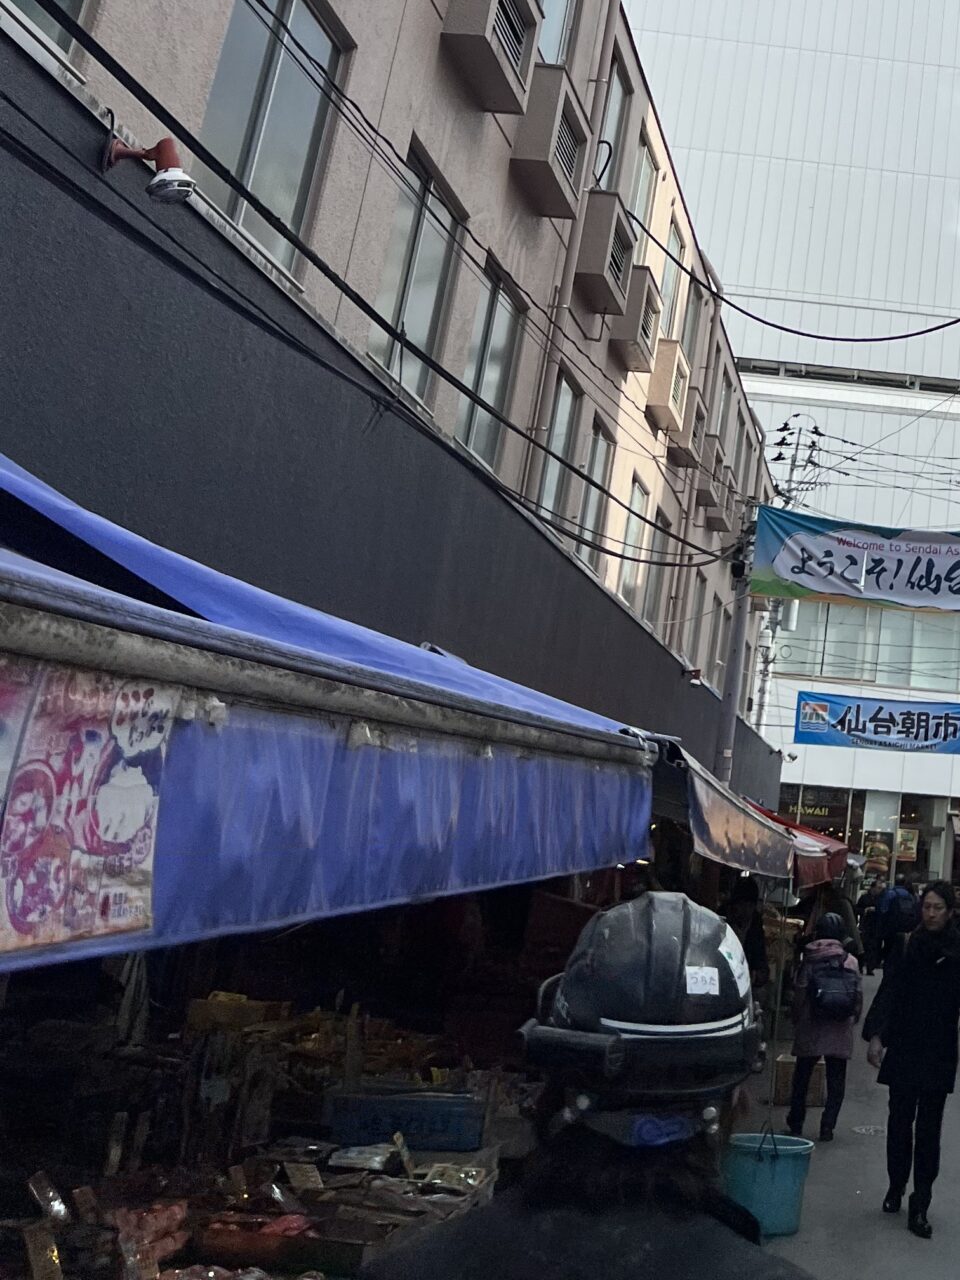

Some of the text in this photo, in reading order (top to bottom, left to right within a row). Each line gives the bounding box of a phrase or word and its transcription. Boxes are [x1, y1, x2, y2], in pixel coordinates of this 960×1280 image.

[836, 536, 885, 552] Welcome
[889, 542, 902, 553] to
[904, 543, 943, 556] Sendai
[789, 805, 829, 816] HAWAII
